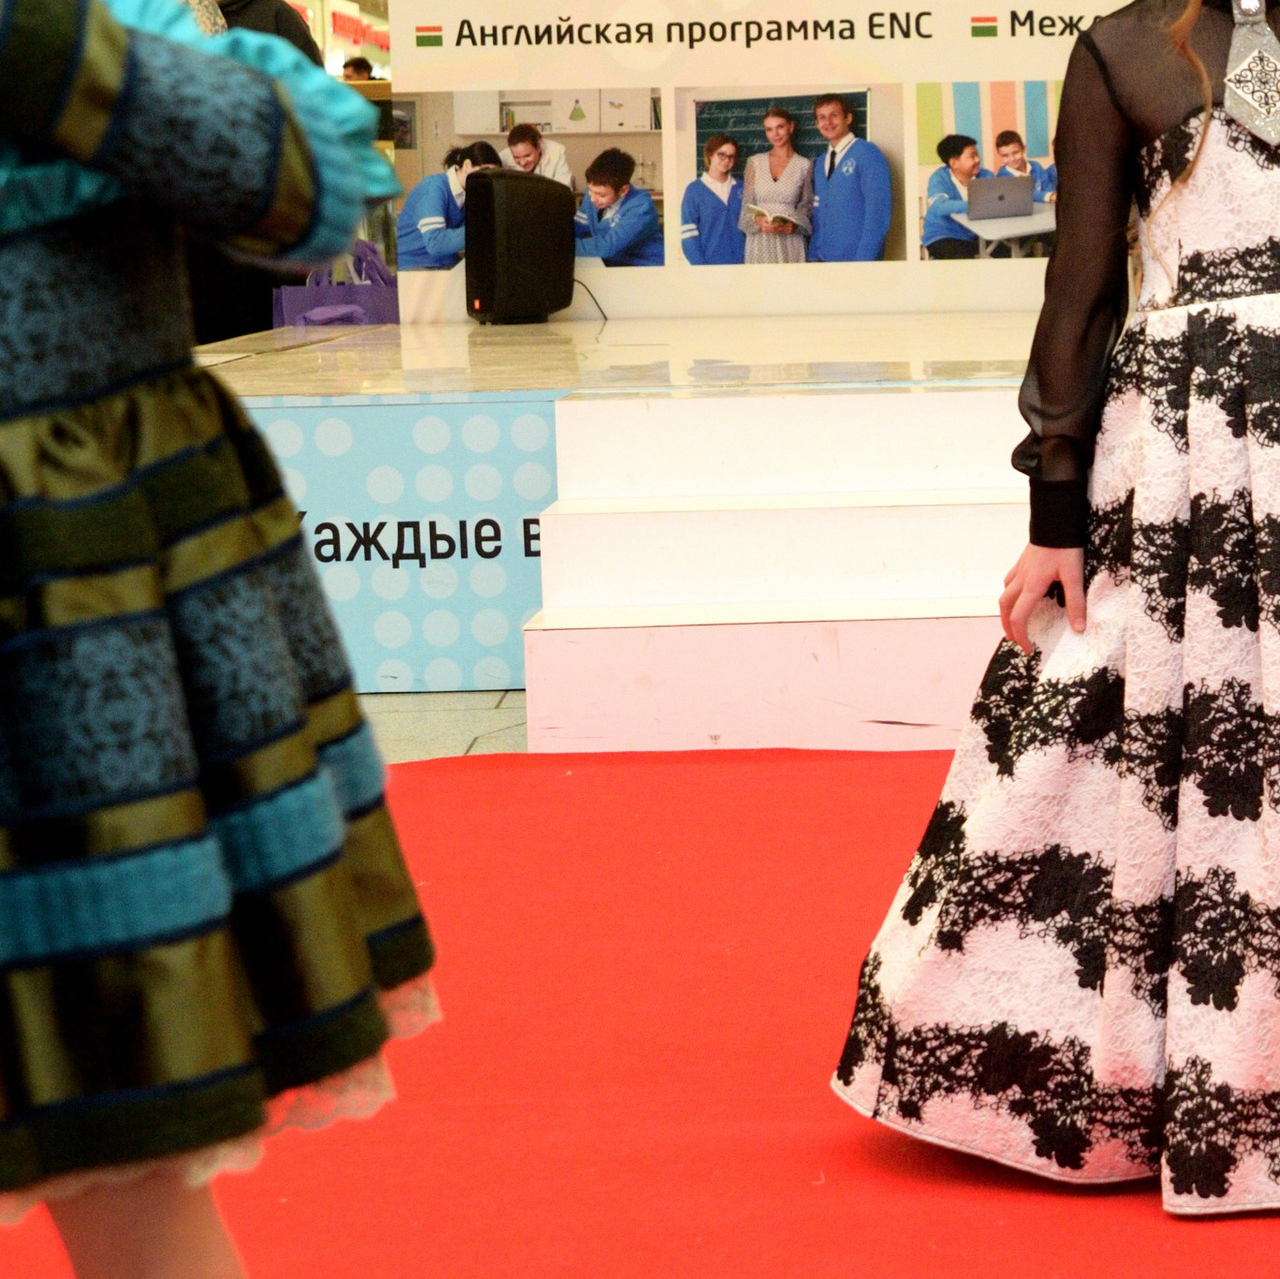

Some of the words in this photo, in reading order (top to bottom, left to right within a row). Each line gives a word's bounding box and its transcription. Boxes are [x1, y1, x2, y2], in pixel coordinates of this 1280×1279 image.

[455, 16, 655, 47] Английская
[666, 19, 856, 50] программа
[868, 11, 933, 41] ENC
[297, 509, 503, 570] аждые
